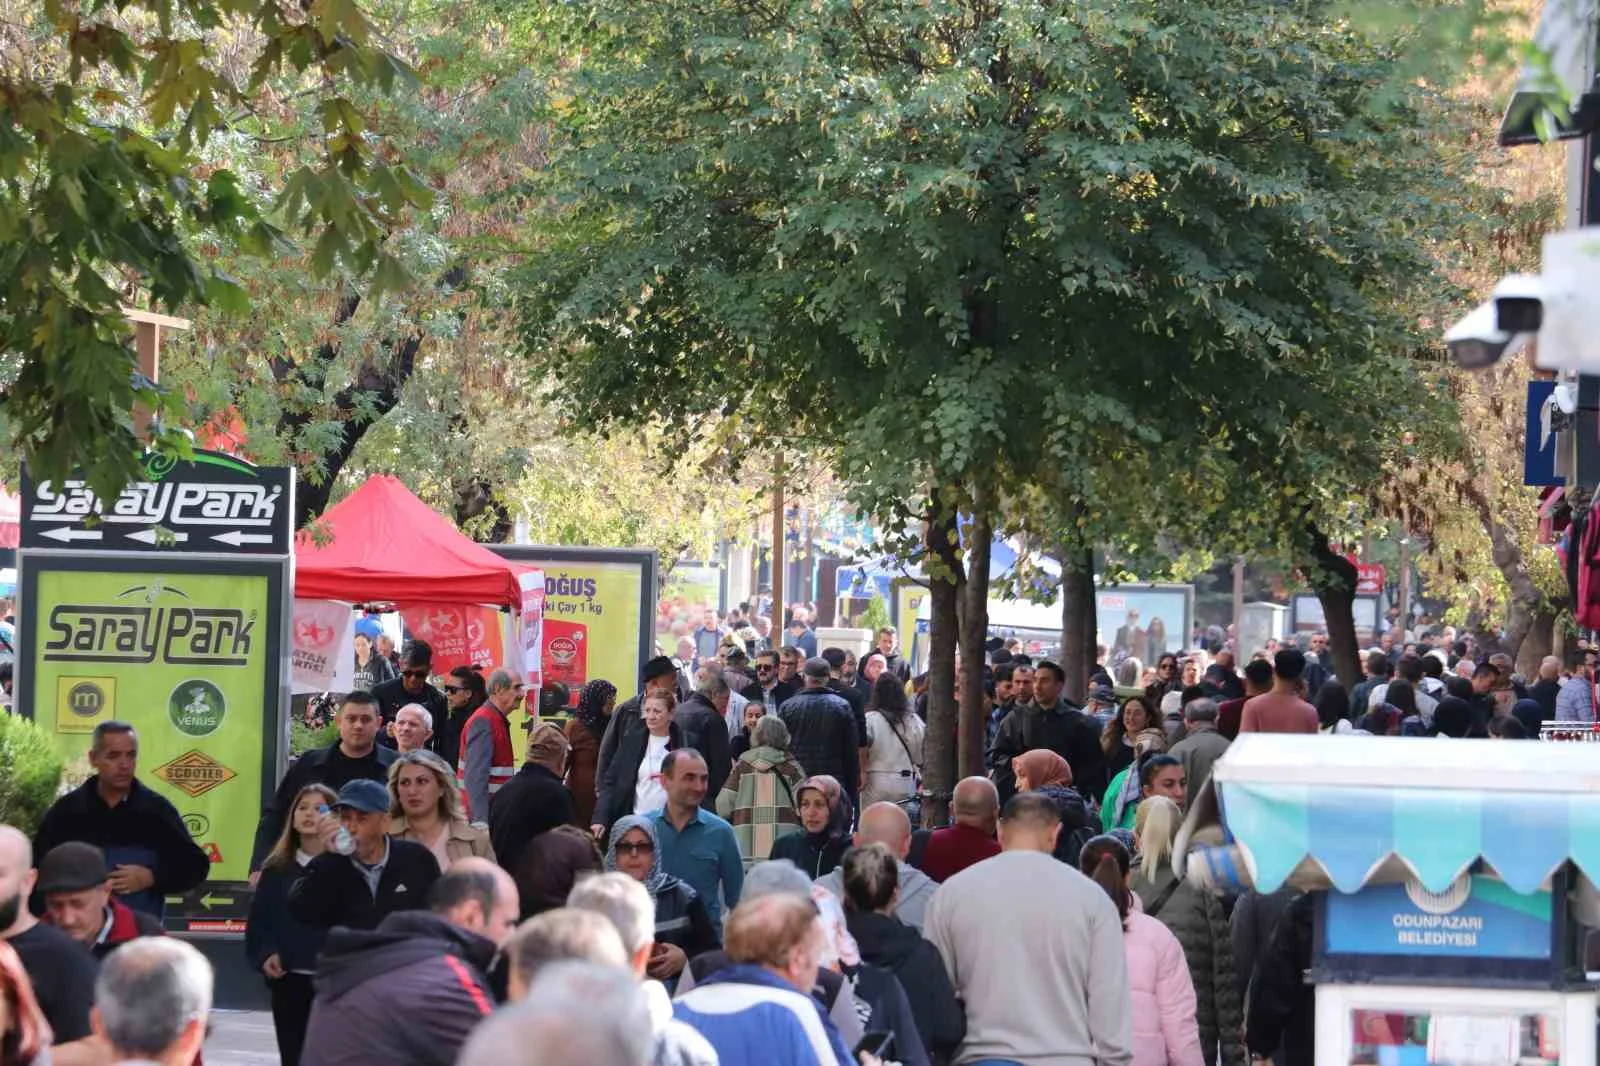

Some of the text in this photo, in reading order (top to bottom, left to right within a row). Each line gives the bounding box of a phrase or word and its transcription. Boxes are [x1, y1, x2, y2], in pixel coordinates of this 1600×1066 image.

[544, 573, 596, 601] OĞUŞ
[177, 716, 216, 727] VENUS
[165, 766, 224, 780] SCOOTER
[1393, 914, 1482, 929] ODUNPAZARI
[1398, 931, 1477, 946] BELEDİYESİ
